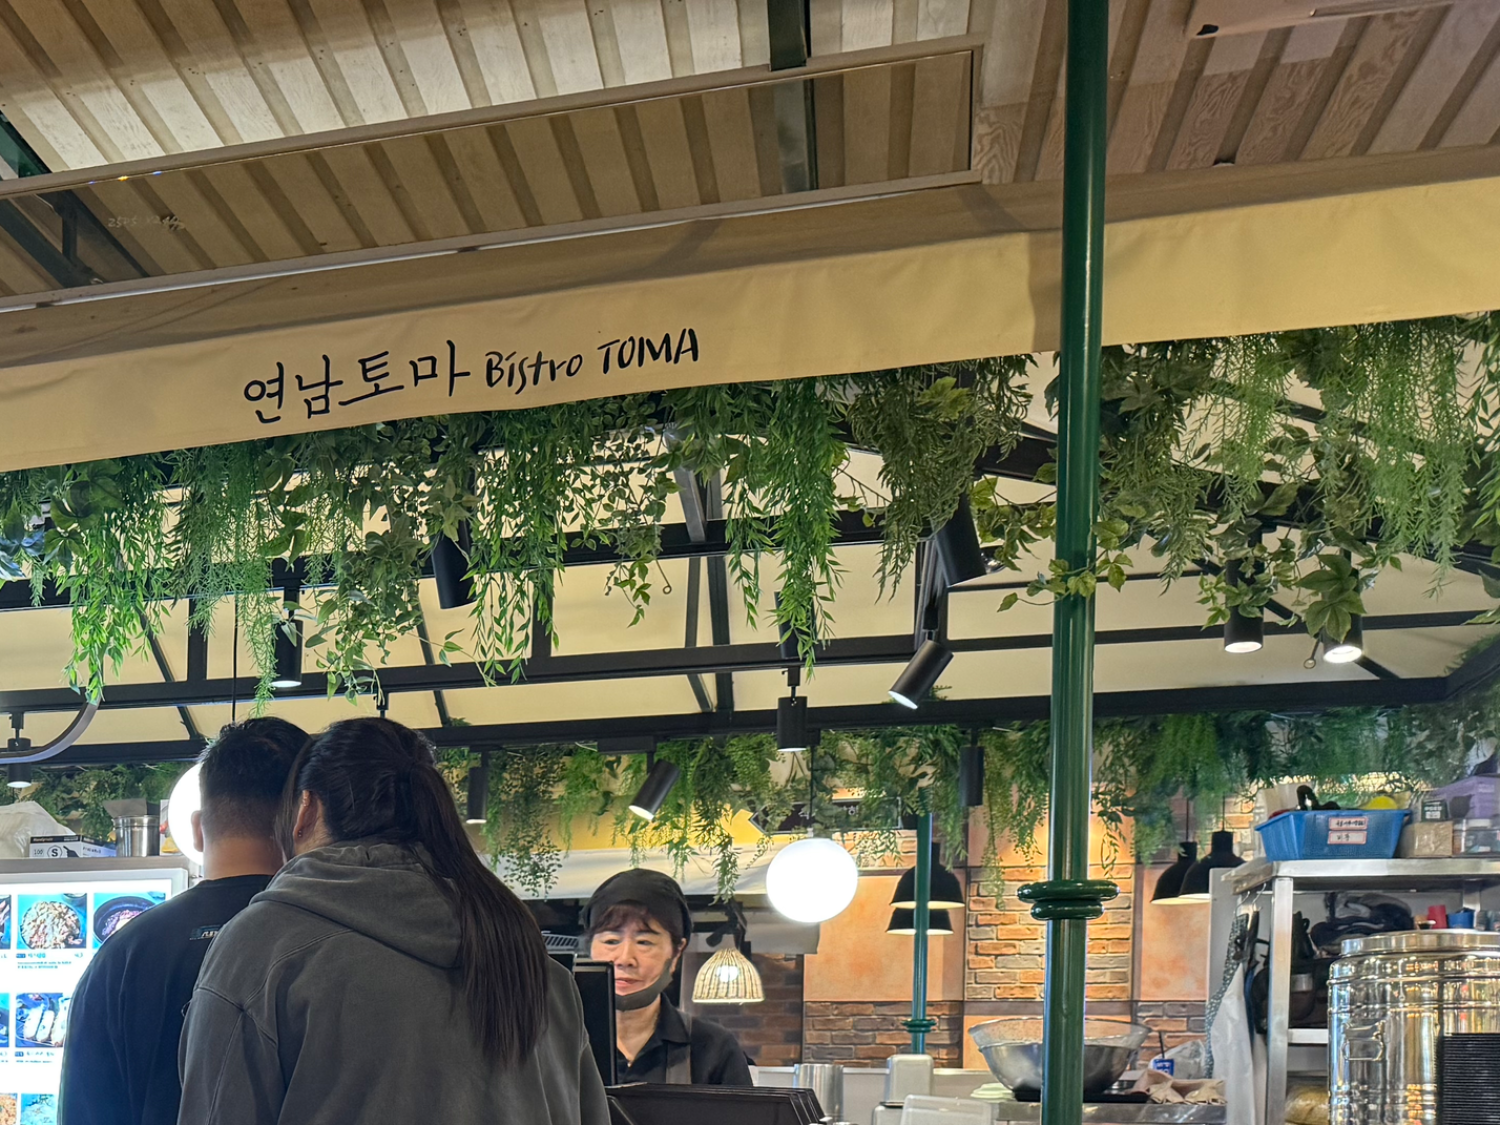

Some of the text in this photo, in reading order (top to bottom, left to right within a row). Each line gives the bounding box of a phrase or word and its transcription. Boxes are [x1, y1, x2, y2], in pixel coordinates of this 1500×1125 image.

[243, 328, 699, 424] 연남토마 Bistro TOMA
[51, 848, 59, 857] S
